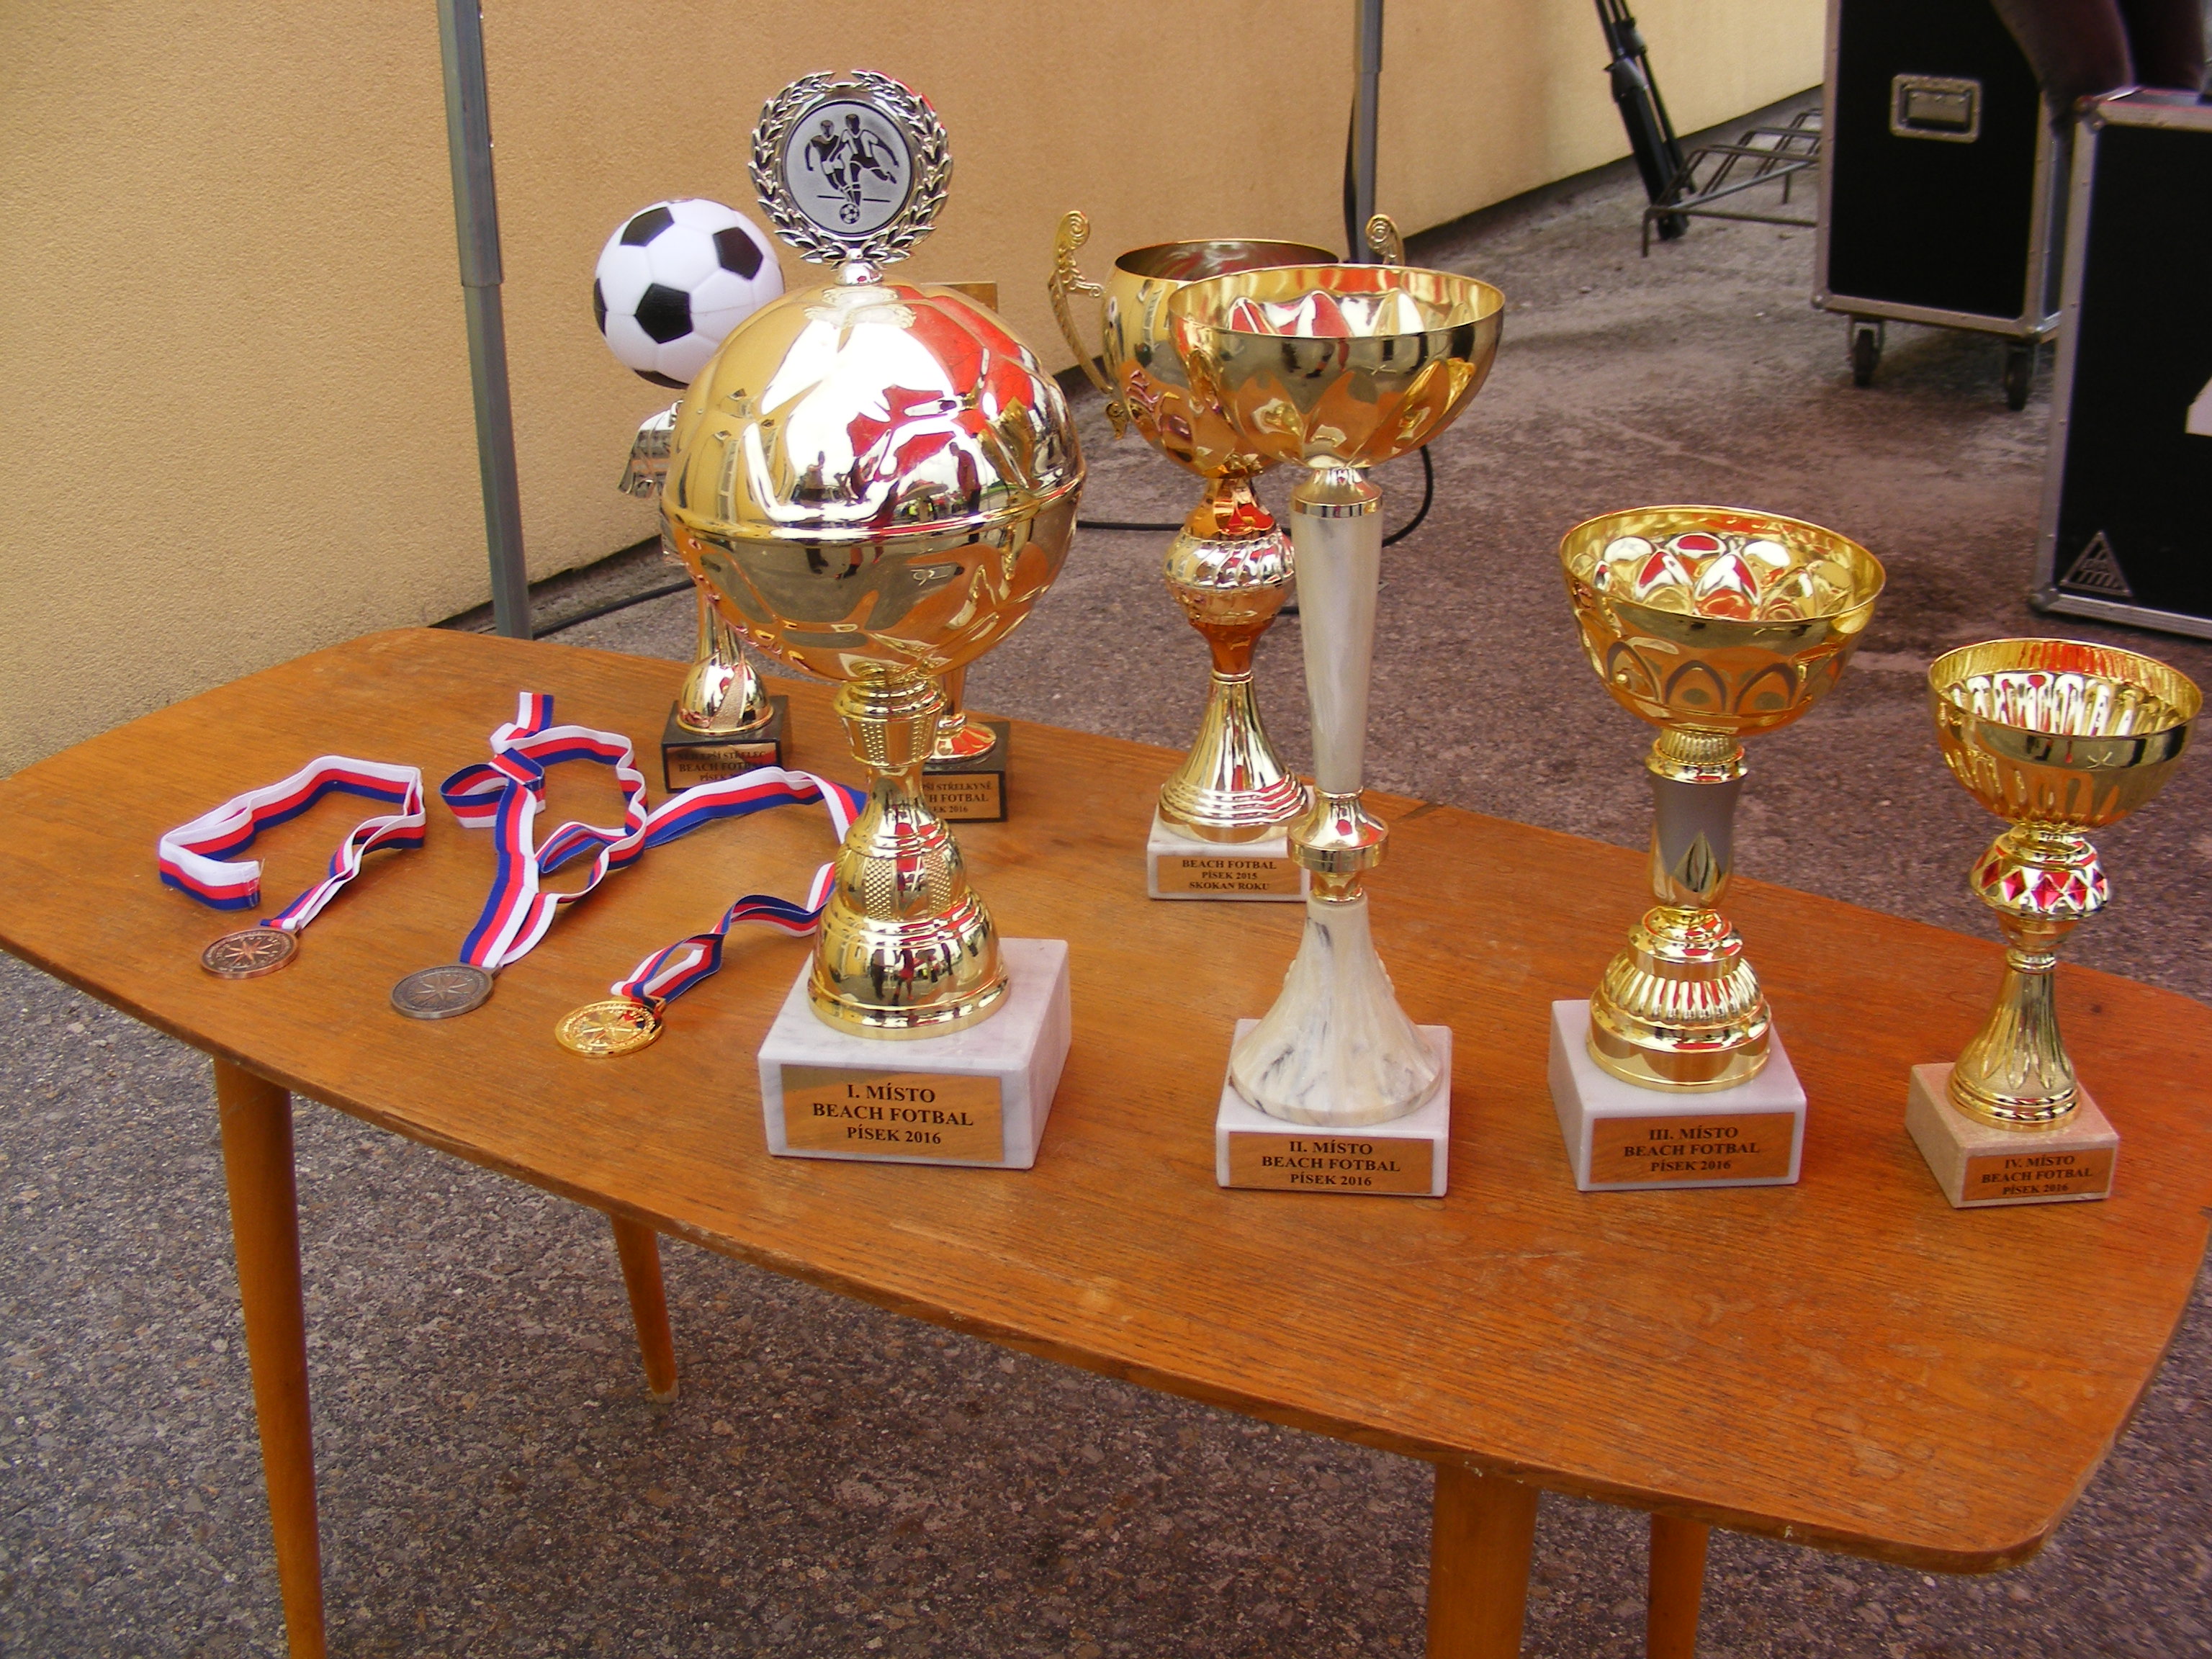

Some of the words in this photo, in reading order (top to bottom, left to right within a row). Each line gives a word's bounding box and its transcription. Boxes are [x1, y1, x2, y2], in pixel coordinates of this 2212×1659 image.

[679, 763, 718, 772] BEACH
[941, 793, 989, 802] FOTBAL
[1182, 860, 1224, 868] BEACH
[1228, 860, 1277, 869] FOTBAL
[1202, 871, 1233, 879] PÍSEK
[848, 1084, 860, 1098] I.
[867, 1083, 935, 1103] MÍSTO
[813, 1103, 882, 1120] BEACH
[891, 1107, 974, 1126] FOTBAL
[847, 1124, 900, 1141] PÍSEK
[906, 1130, 942, 1144] 2016
[1649, 1129, 1673, 1140] III.
[1680, 1125, 1738, 1139] MÍSTO
[1290, 1141, 1307, 1152] II.
[1313, 1140, 1372, 1155] MÍSTO
[1624, 1145, 1685, 1157] BEACH
[1691, 1143, 1760, 1155] FOTBAL
[1262, 1156, 1323, 1169] BEACH
[1329, 1159, 1401, 1172] FOTBAL
[1651, 1160, 1696, 1172] PÍSEK
[1701, 1161, 1731, 1170] 2016
[2005, 1159, 2022, 1169] IV.
[2026, 1154, 2075, 1167] MÍSTO
[1290, 1172, 1336, 1184] PÍSEK
[1341, 1176, 1372, 1186] 2016
[1982, 1172, 2031, 1183] BEACH
[2036, 1168, 2093, 1179] FOTBAL
[2002, 1184, 2041, 1195] PÍSEK
[2044, 1184, 2069, 1192] 2016
